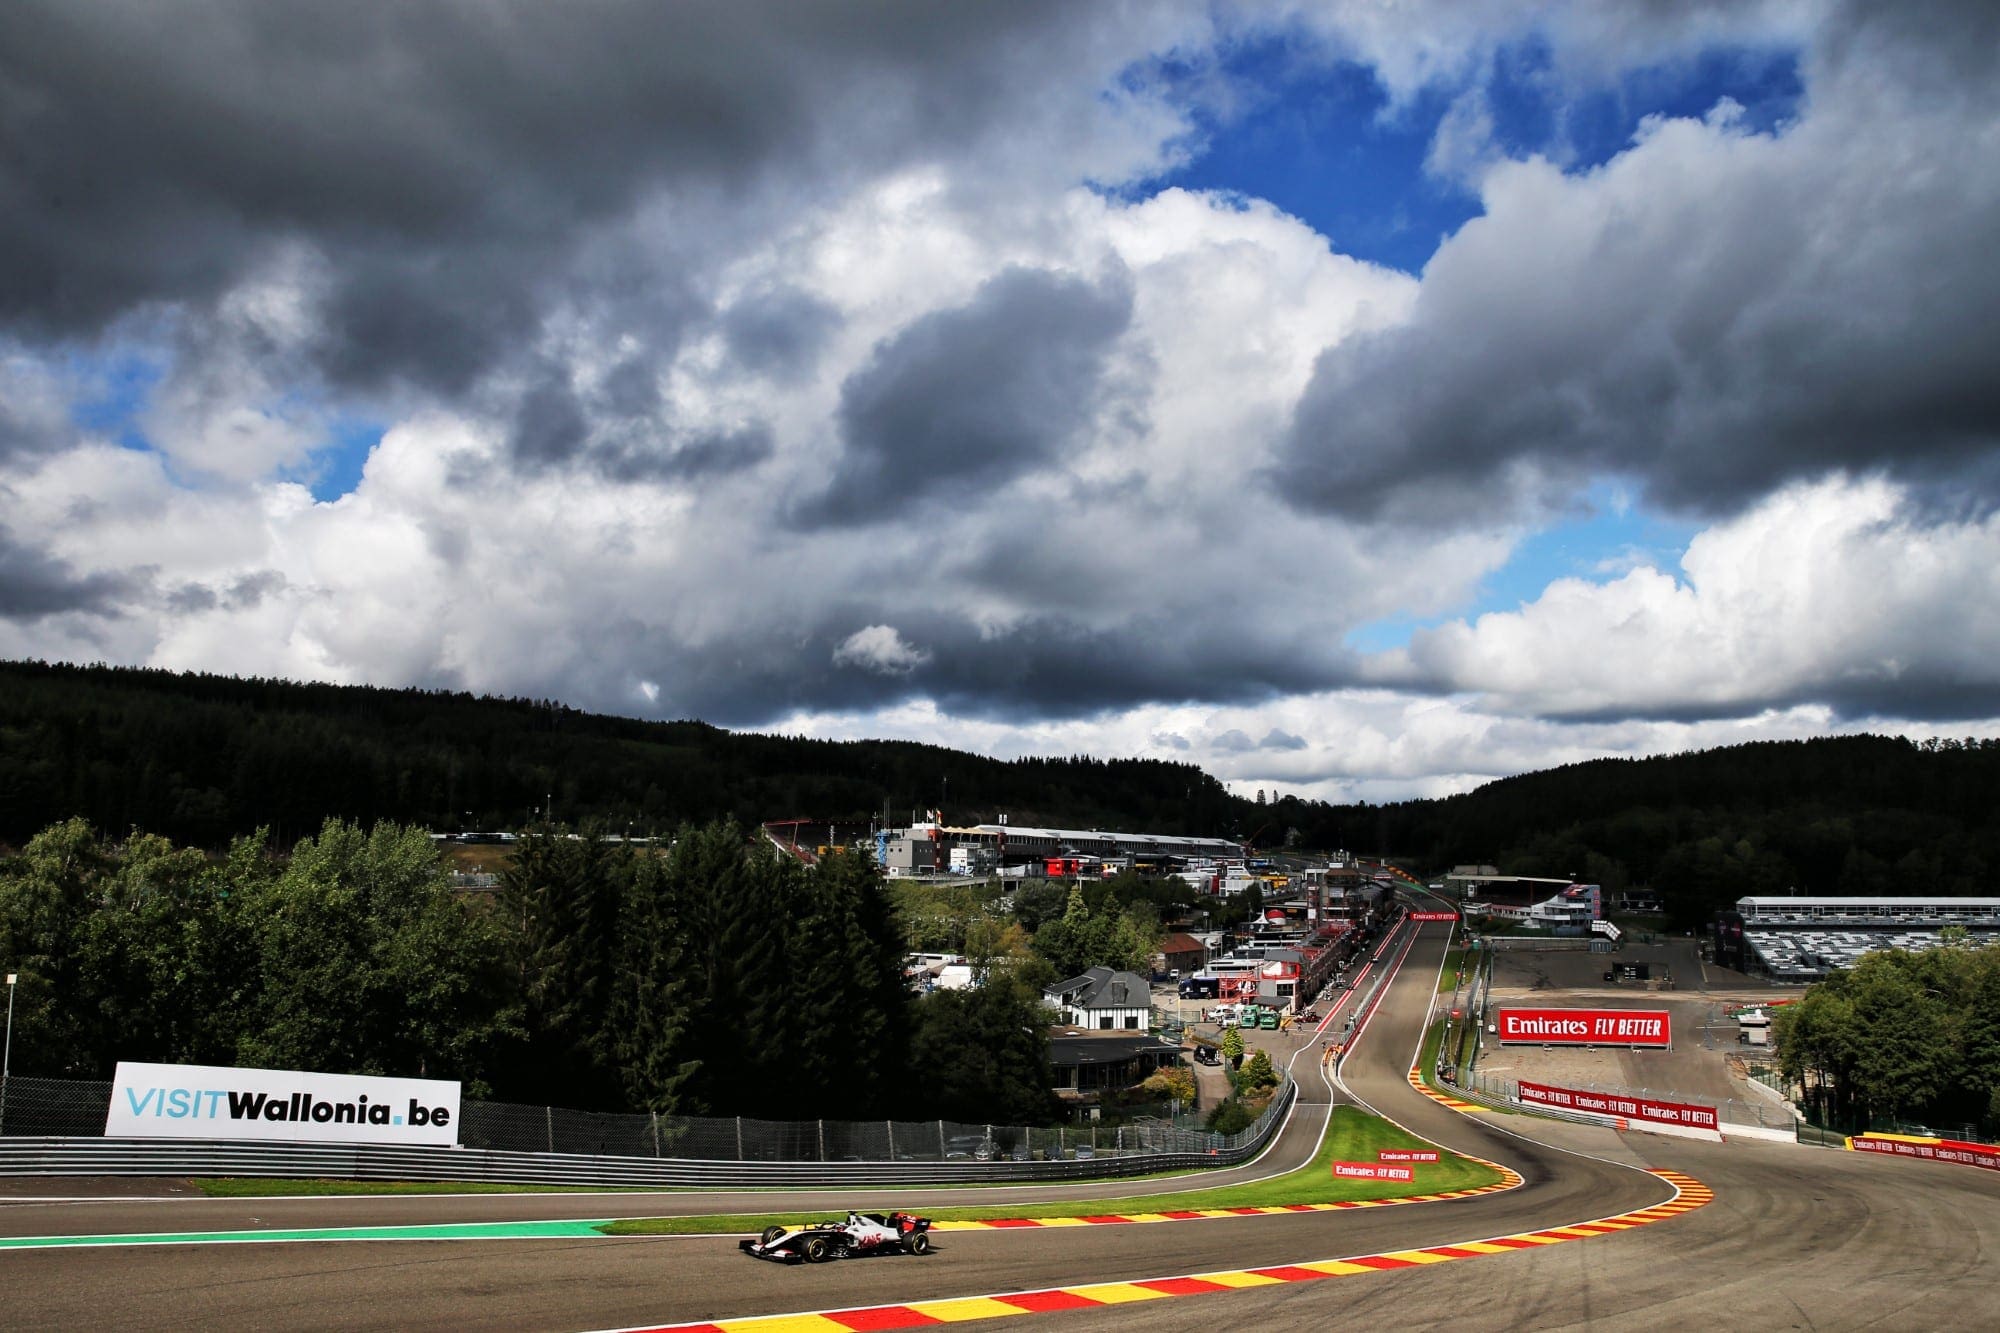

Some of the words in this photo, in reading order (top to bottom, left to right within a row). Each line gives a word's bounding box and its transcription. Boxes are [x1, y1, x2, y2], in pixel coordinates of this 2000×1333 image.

[1507, 1016, 1588, 1034] Emirates
[1595, 1018, 1615, 1035] FLY
[1618, 1019, 1661, 1036] BETTER
[1520, 1086, 1546, 1100] Emirates
[1556, 1092, 1571, 1104] BETTER
[126, 1087, 450, 1126] VISITWallonia.be
[1575, 1095, 1606, 1109] Emirates
[1609, 1102, 1617, 1112] FLY
[1618, 1102, 1636, 1114] BETTER
[1641, 1104, 1678, 1119] Emirates
[1681, 1110, 1691, 1122] FLY
[1692, 1111, 1714, 1124] BETTER
[1853, 1140, 1875, 1150] Emirates
[1380, 1152, 1410, 1160] Emirates
[1335, 1165, 1374, 1177] Emirates
[1377, 1168, 1387, 1177] FLY
[1388, 1169, 1409, 1179] BETTER
